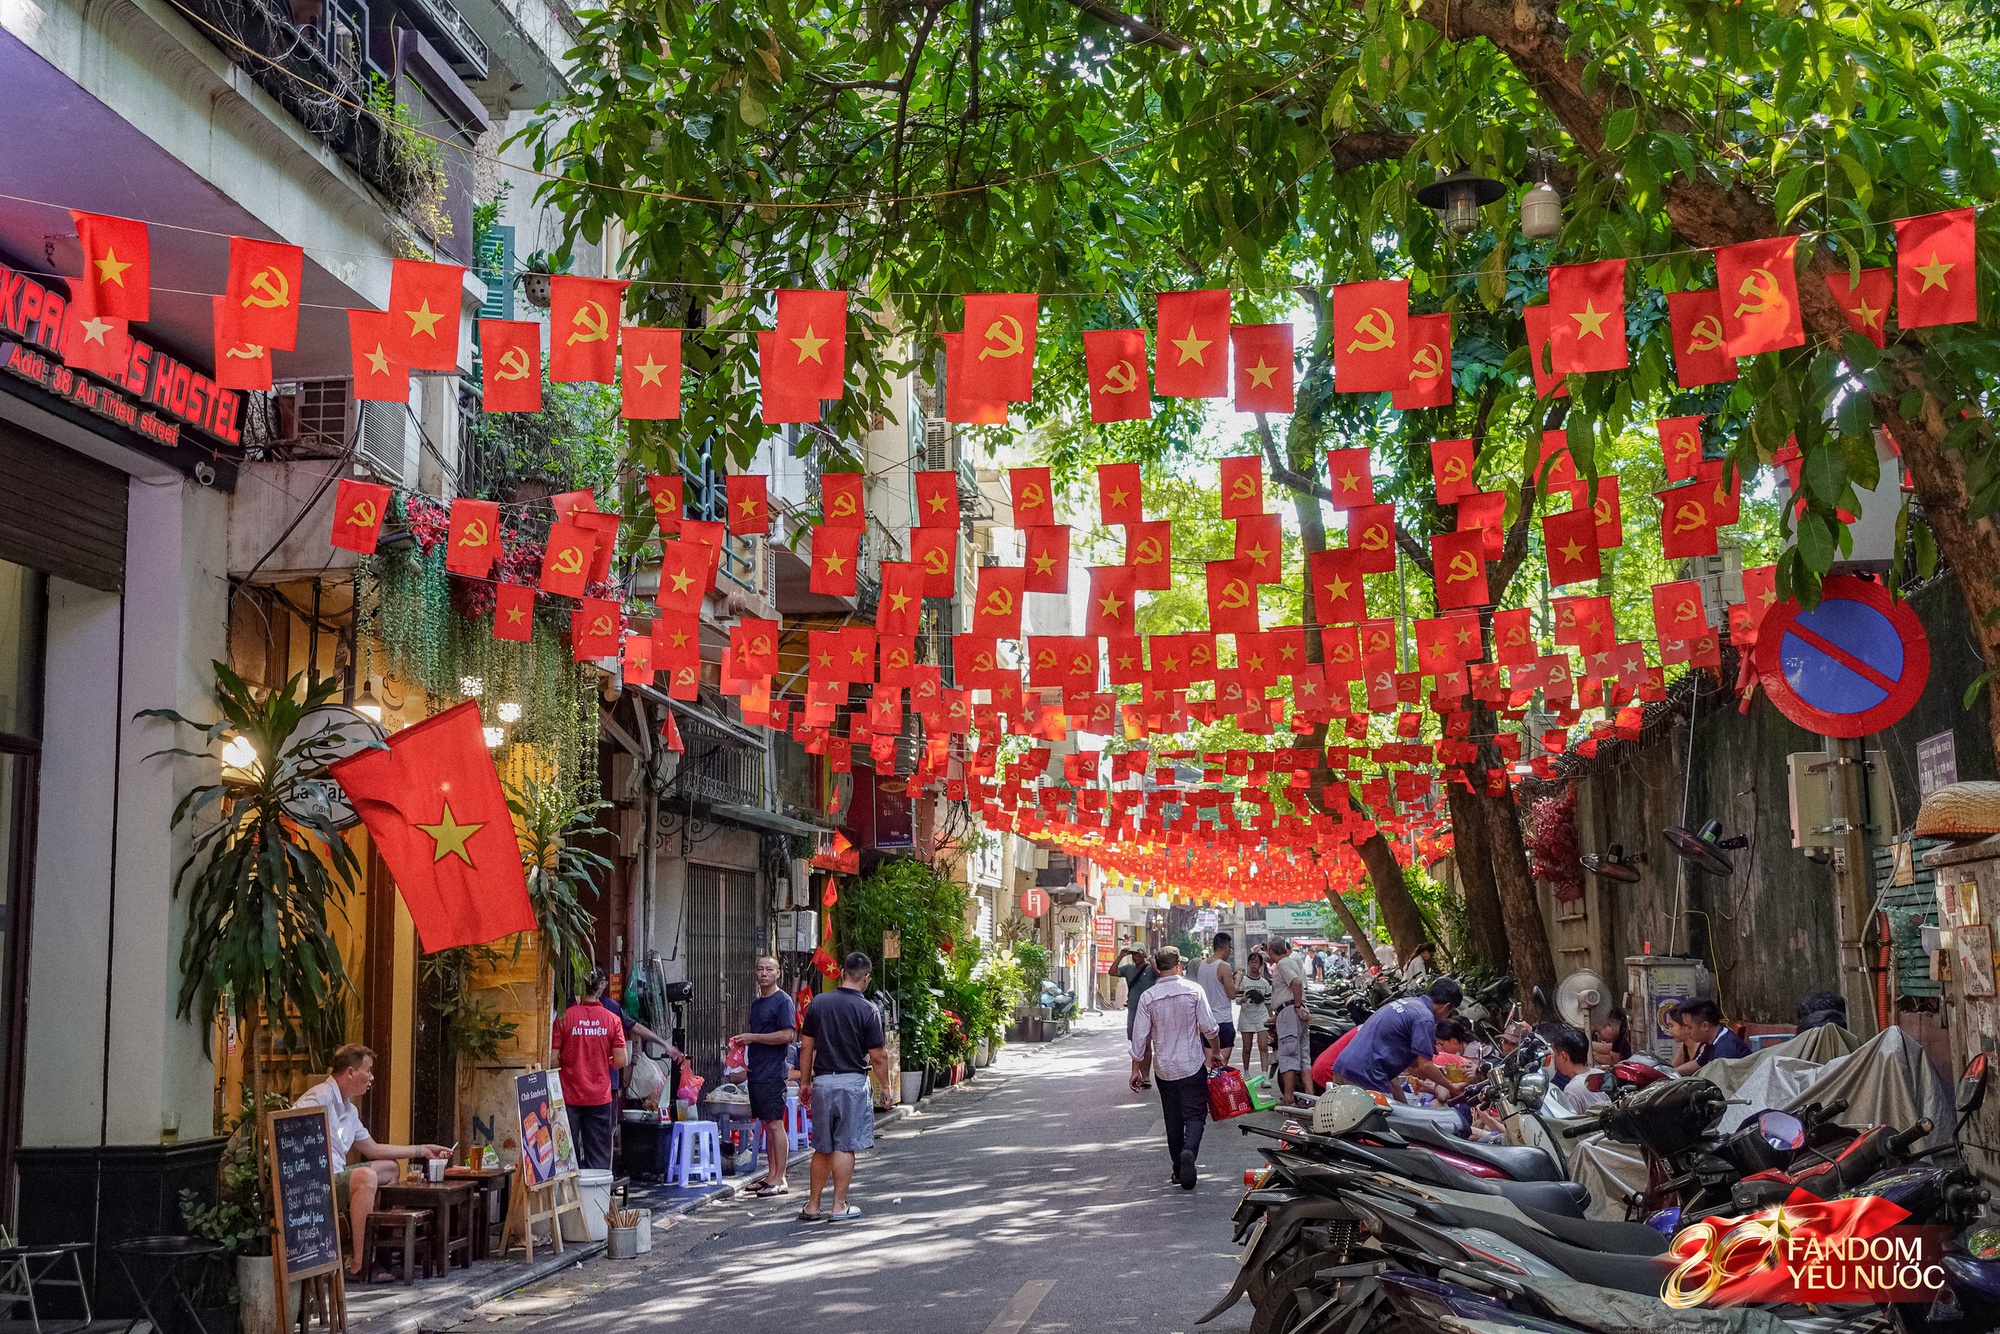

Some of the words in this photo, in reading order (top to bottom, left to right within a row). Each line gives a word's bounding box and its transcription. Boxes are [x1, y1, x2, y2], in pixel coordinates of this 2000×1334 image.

[8, 344, 49, 385] Add:
[52, 364, 73, 395] 38
[74, 377, 98, 408] Au
[102, 387, 138, 426] Trieu
[140, 411, 180, 447] street
[152, 352, 240, 446] HOSTEL
[289, 786, 309, 800] La
[1060, 914, 1081, 924] NAIL
[572, 1025, 583, 1036] ẤU
[584, 1026, 608, 1037] TRIỆU
[530, 1087, 547, 1100] Sandwich
[283, 1161, 294, 1180] Egg
[295, 1158, 311, 1172] Coffee
